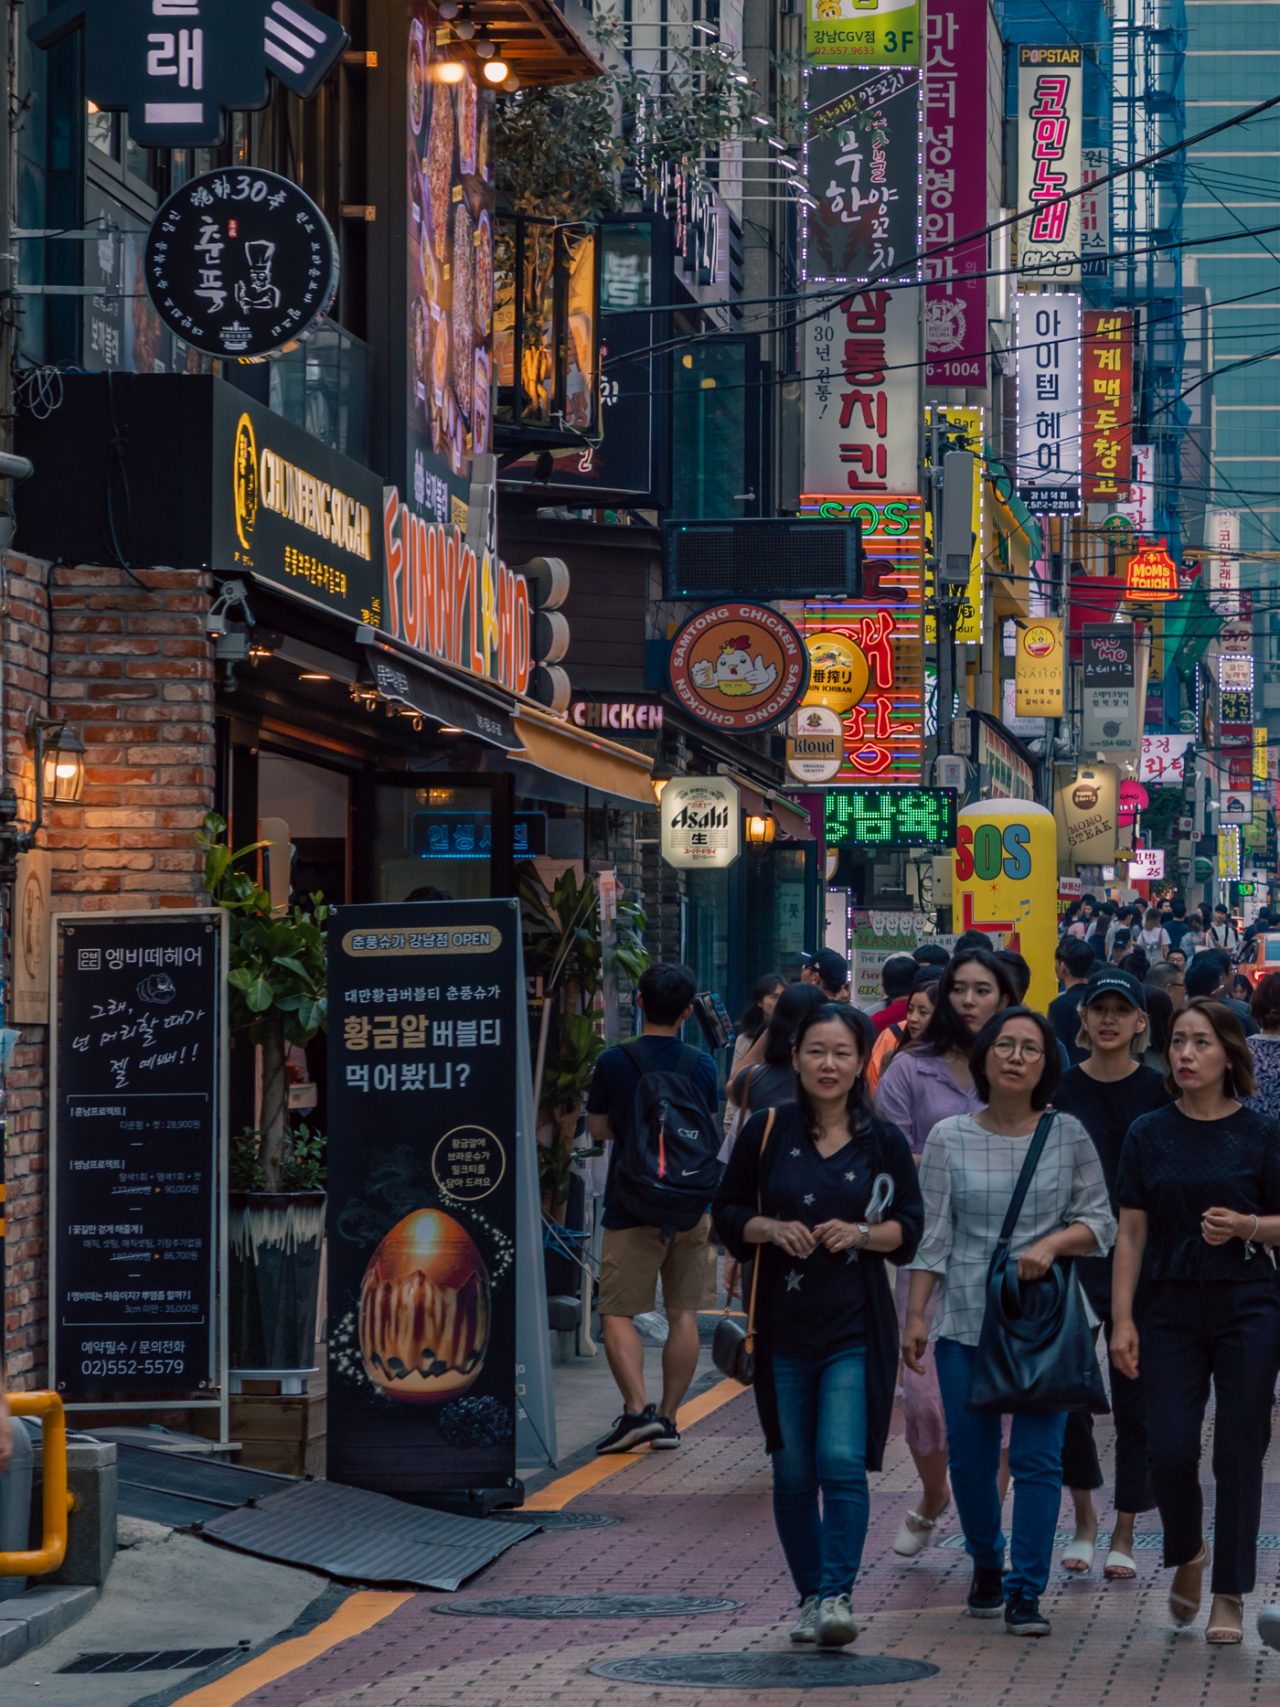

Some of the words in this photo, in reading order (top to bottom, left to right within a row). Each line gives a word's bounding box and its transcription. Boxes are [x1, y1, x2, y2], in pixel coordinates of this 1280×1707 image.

[814, 31, 875, 44] 강남CGV점
[884, 31, 913, 53] 3F
[926, 12, 959, 296] 마스터성형외과
[1029, 75, 1072, 243] 코인노래
[867, 187, 900, 272] 양꼬치
[838, 290, 893, 490] 삼통치킨
[1093, 317, 1121, 493] 세계맥주창고
[331, 487, 372, 562] SUGAR
[1132, 577, 1170, 589] TOUCH
[674, 608, 730, 667] SAMTONG
[739, 607, 798, 655] CHICKEN
[676, 678, 735, 725] CHICKEN
[744, 664, 799, 723] SAMTONG
[822, 684, 852, 693] ICHIBAN
[573, 702, 664, 731] CHICKEN
[671, 806, 729, 829] Asahi
[1068, 814, 1103, 835] MOMO
[691, 832, 708, 845] 生
[1068, 820, 1113, 847] STEAK
[955, 823, 1031, 881] SOS
[1147, 867, 1161, 877] 25
[1061, 882, 1081, 891] 부동산
[351, 935, 405, 950] 춘풍슈가
[409, 933, 449, 948] 강남점
[453, 933, 490, 947] OPEN
[344, 987, 441, 1004] 대만황금버블티
[446, 984, 501, 1001] 춘풍슈가
[90, 999, 134, 1019] 그래,
[343, 1014, 430, 1050] 황금알
[431, 1018, 501, 1048] 버블티
[345, 1062, 472, 1093] 먹어봤니?
[81, 1340, 128, 1354] 예약필수
[139, 1340, 186, 1353] 문의전화
[81, 1359, 184, 1377] 02)552-5579
